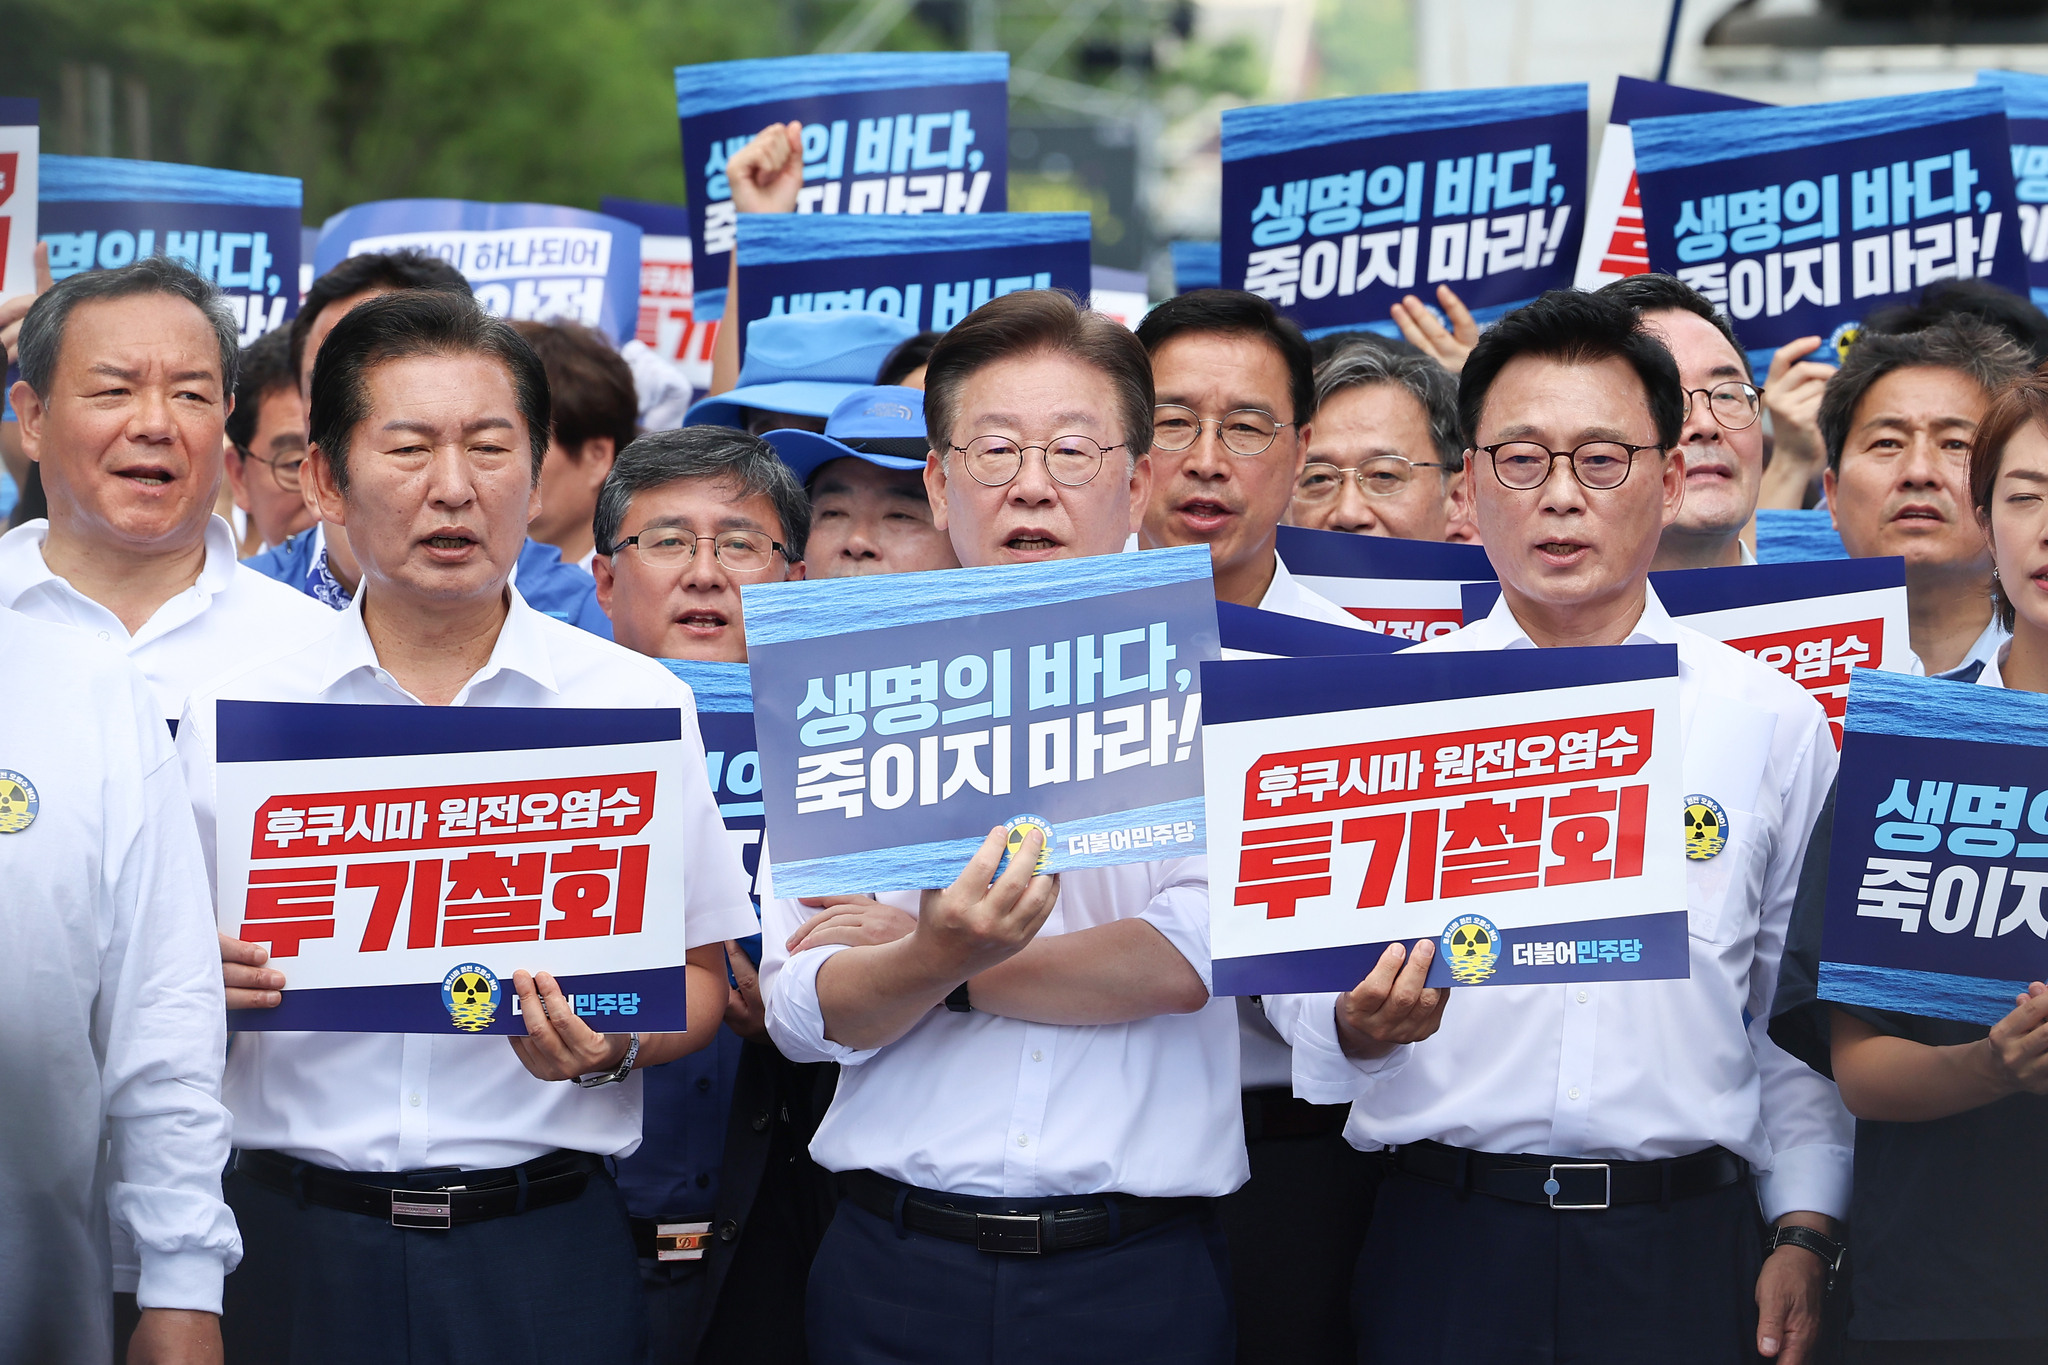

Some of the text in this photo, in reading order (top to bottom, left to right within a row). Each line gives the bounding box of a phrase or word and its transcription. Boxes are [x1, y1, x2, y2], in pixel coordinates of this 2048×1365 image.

[704, 119, 848, 201] 생의
[853, 109, 984, 175] 바다,
[1251, 143, 1566, 247] 생명의 바다,
[1674, 173, 1840, 263] 생명의
[1851, 148, 1992, 231] 바다,
[163, 229, 282, 296] 바다,
[474, 239, 601, 271] 하나되어
[1244, 226, 1420, 307] 죽이지
[1427, 205, 1572, 284] 마라!
[1676, 242, 1841, 321] 죽이지
[1852, 211, 2003, 300] 마라!
[797, 621, 1192, 748] 생명의 바다,
[1743, 634, 1870, 680] 오염수
[796, 725, 1012, 819] 죽이지
[1029, 692, 1203, 789] 마라!
[1256, 725, 1640, 808] 후쿠시마 원전오염수
[264, 789, 642, 849] 후쿠시마 원전오염수
[1068, 821, 1197, 856] 더불어민주당
[1233, 784, 1650, 921] 투기철회
[238, 843, 651, 959] 투기철회
[1512, 938, 1644, 967] 더불어민주당
